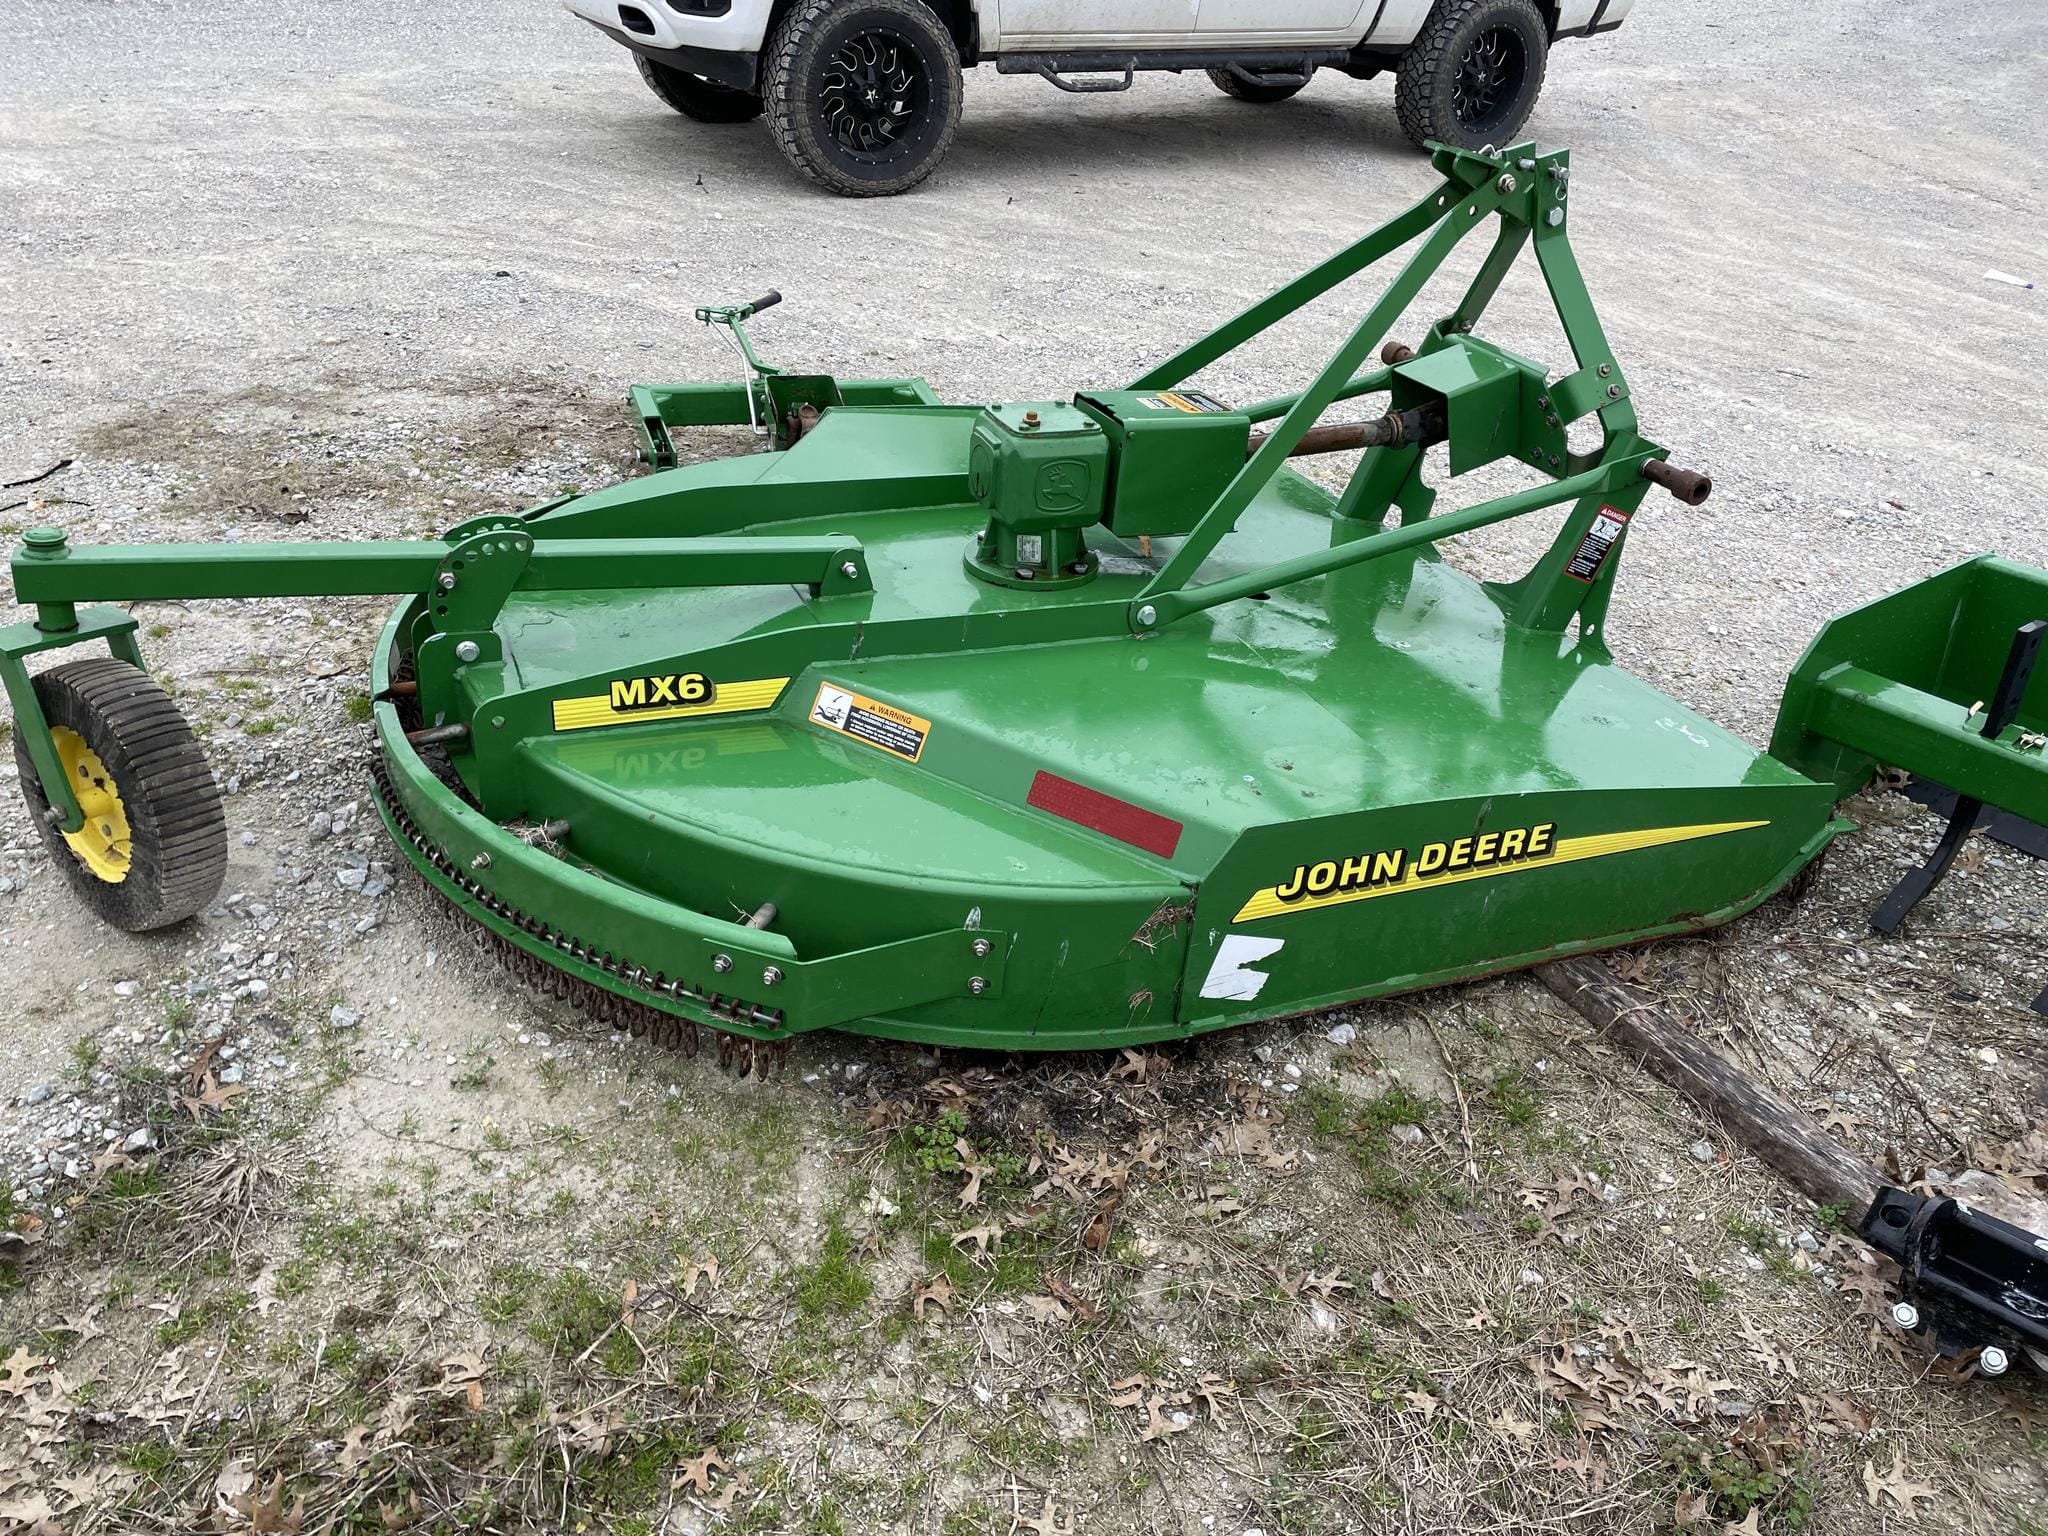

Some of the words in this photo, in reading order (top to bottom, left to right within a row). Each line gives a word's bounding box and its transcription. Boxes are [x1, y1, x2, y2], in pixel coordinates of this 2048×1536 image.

[1606, 509, 1627, 522] DANGER
[610, 673, 708, 709] MX6
[879, 706, 912, 725] WARNING
[1276, 849, 1405, 899] JOHN
[1416, 823, 1554, 875] DEERE
